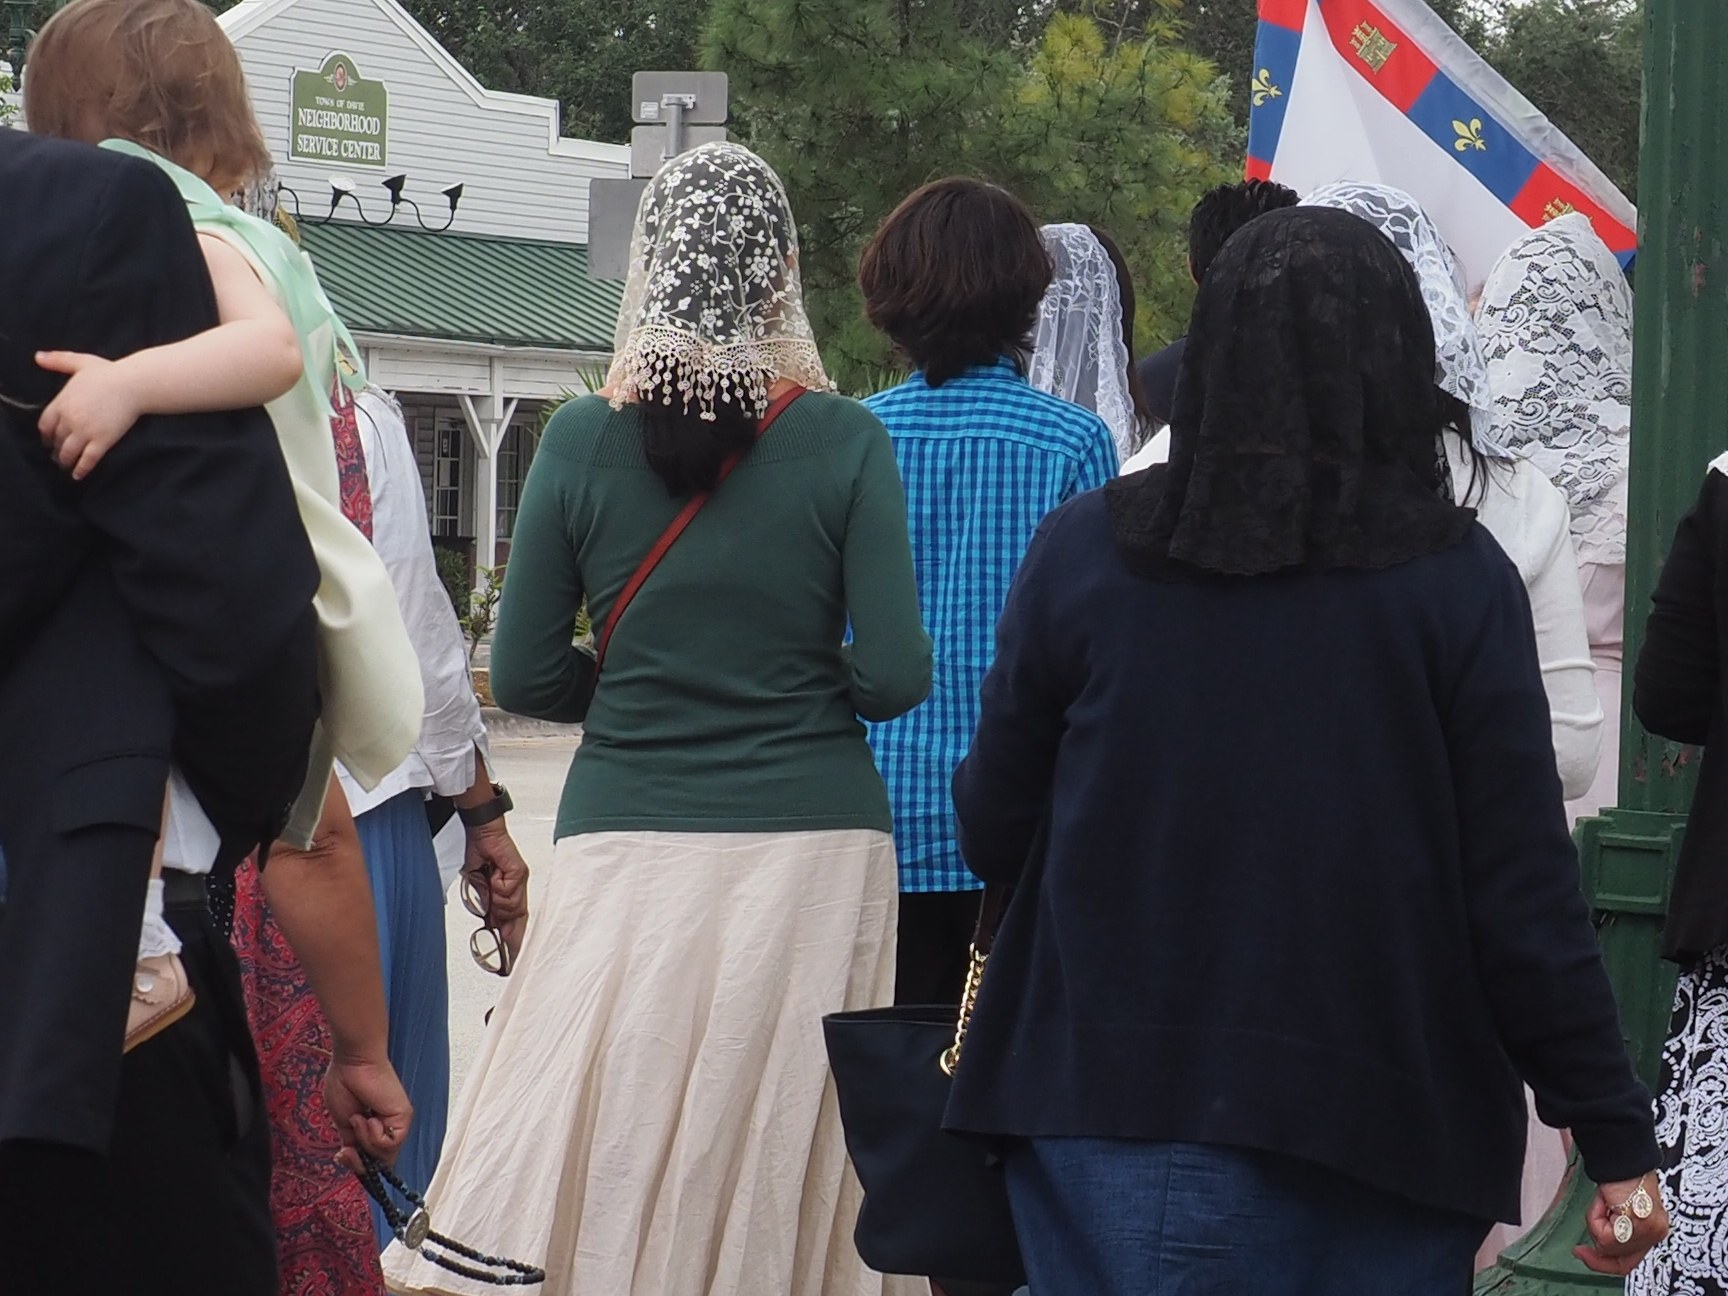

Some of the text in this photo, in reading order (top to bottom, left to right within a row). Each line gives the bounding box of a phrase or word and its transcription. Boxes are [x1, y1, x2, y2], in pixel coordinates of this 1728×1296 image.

[298, 107, 381, 135] NEIGHBORHOOD
[297, 134, 381, 161] SERVICE CENTER
